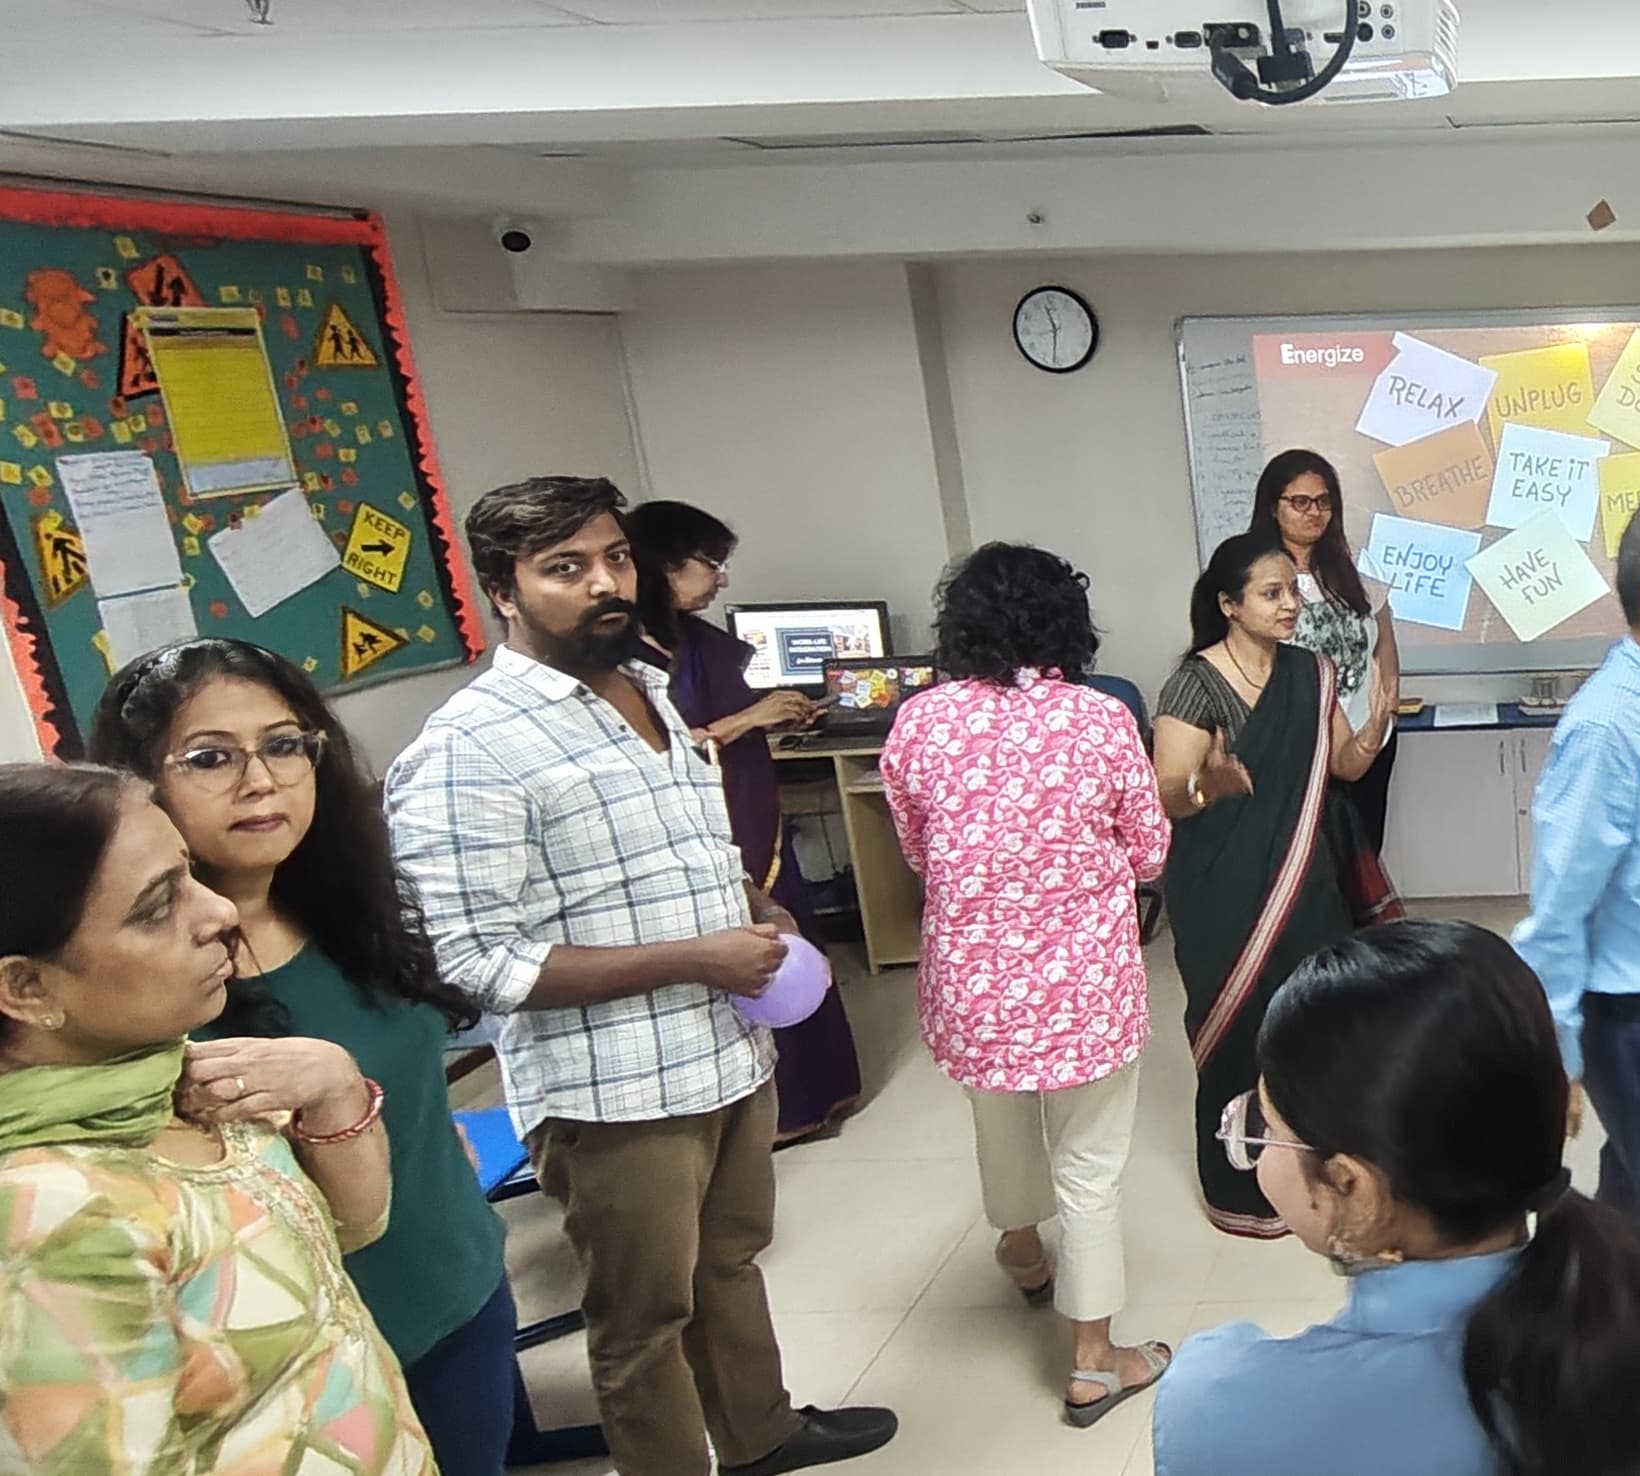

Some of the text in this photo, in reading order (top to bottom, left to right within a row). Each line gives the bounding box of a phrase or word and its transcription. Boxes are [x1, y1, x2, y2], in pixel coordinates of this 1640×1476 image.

[1280, 343, 1364, 367] Energize
[1388, 375, 1465, 419] RELAX
[1495, 382, 1582, 418] UNPLUG
[1509, 452, 1562, 478] TAKE
[1394, 456, 1489, 508] BREATHE
[1512, 479, 1572, 508] EASY
[364, 510, 406, 540] KEEP
[347, 552, 398, 585] RIGHT
[1383, 543, 1454, 576] ENJOY
[1499, 547, 1551, 590] HAVE
[1521, 562, 1564, 605] FUN
